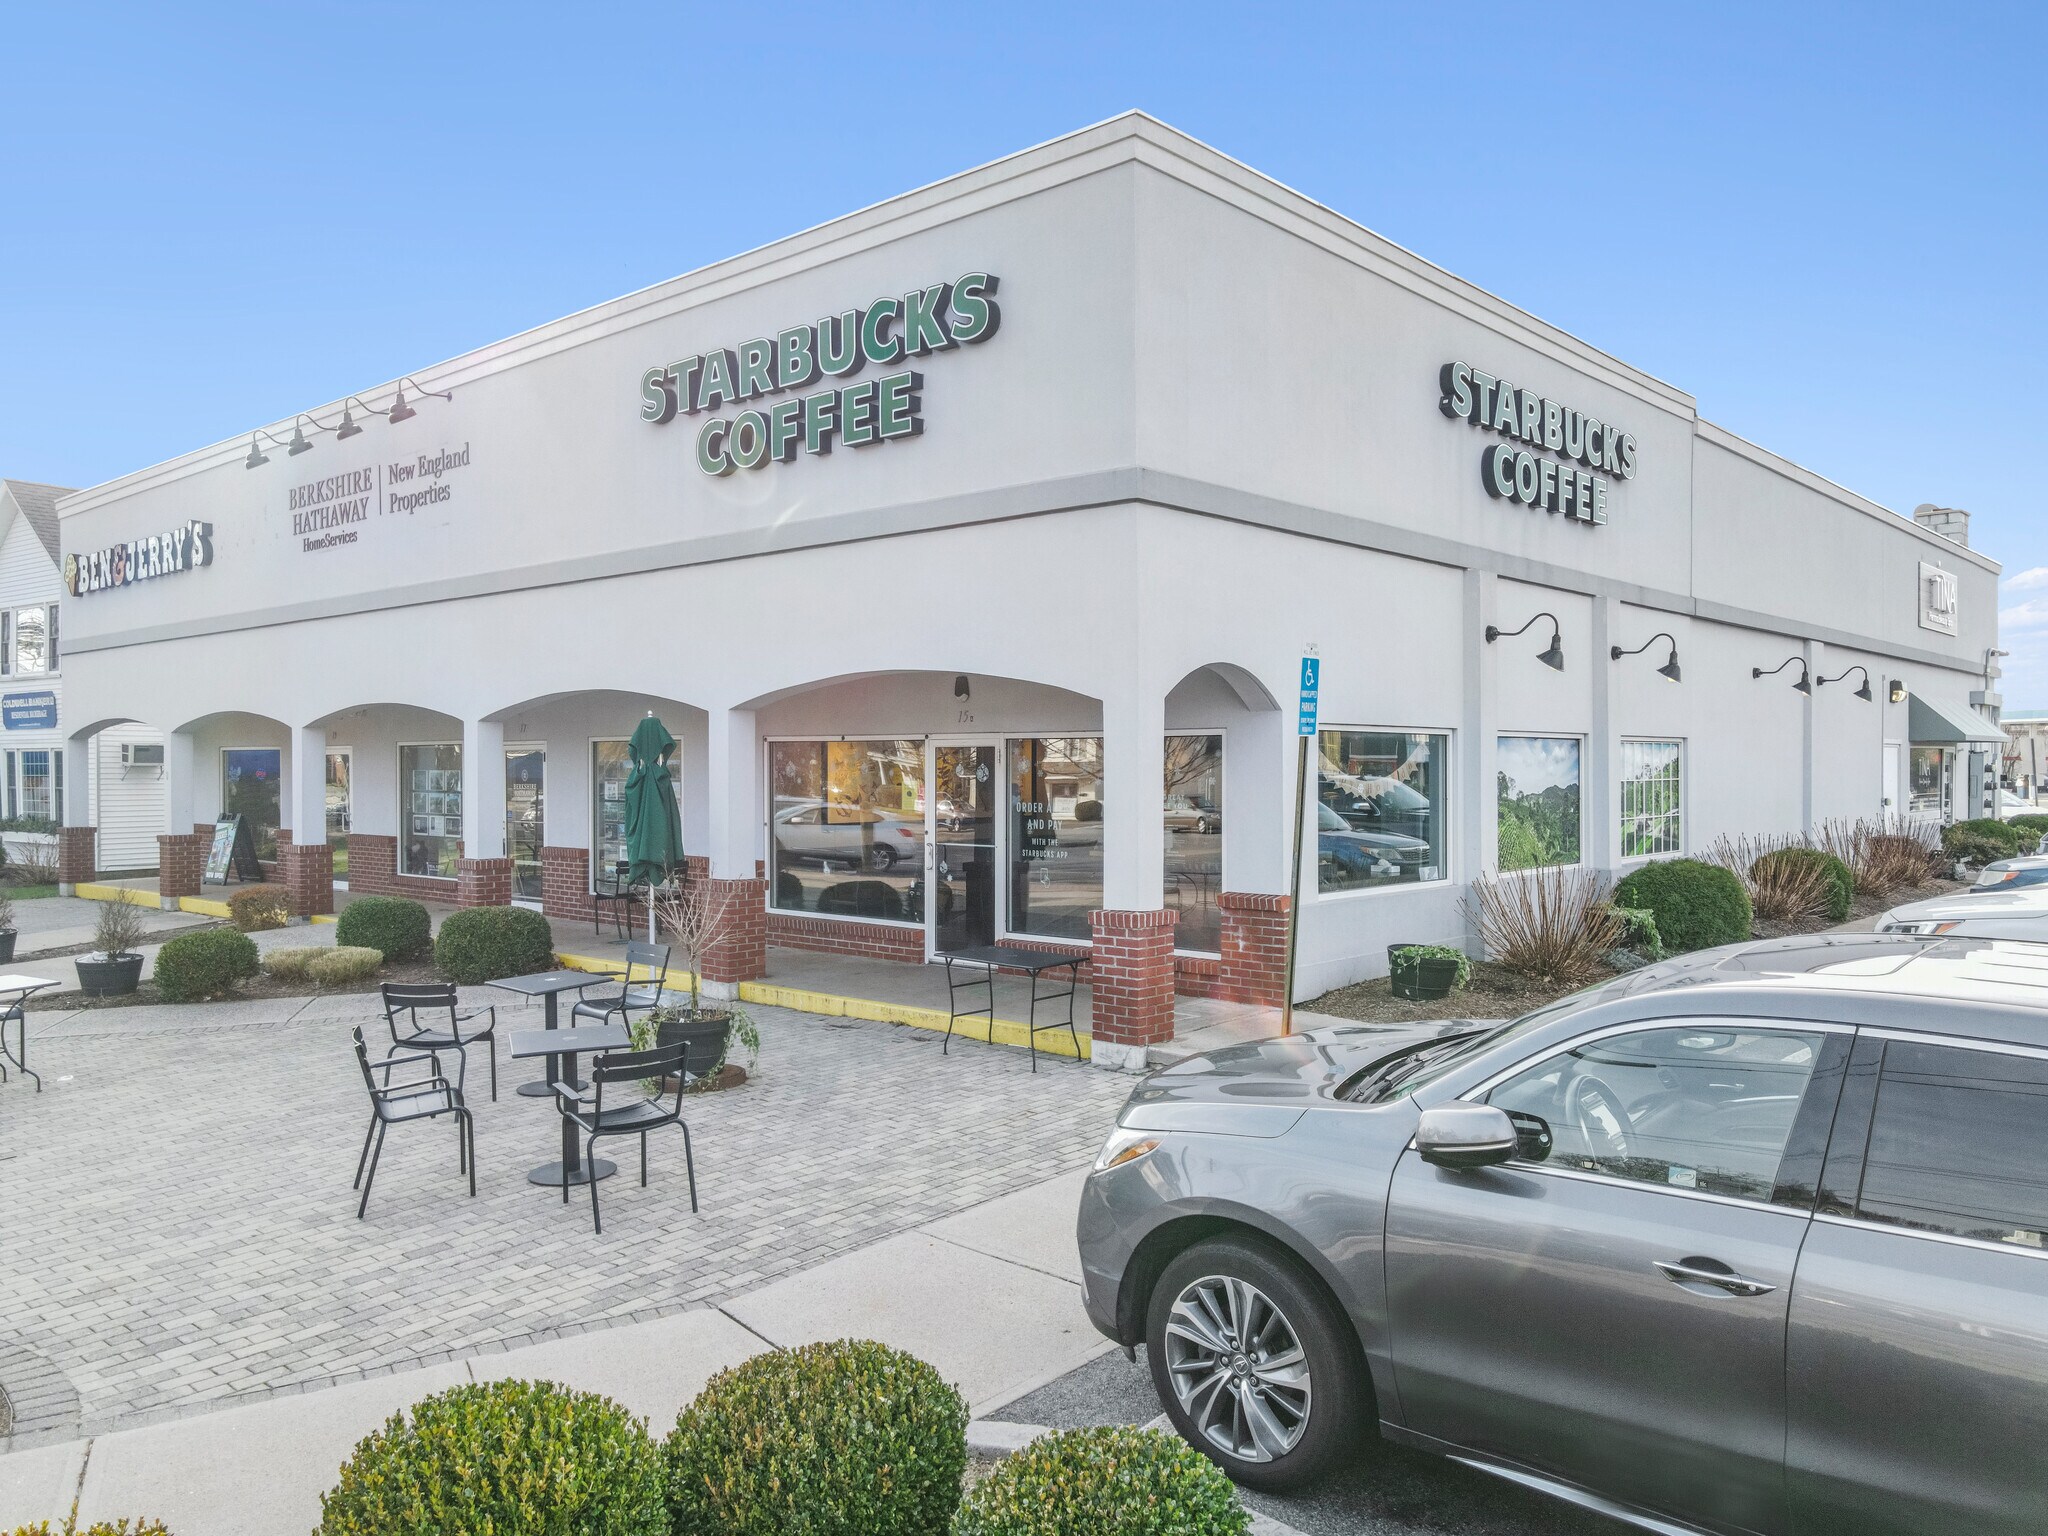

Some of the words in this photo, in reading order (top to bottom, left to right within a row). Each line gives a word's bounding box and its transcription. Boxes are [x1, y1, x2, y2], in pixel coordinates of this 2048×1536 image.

[640, 272, 1000, 424] STARBUCKS
[696, 371, 922, 476] COFFEE
[1439, 361, 1637, 480] STARBUCKS
[388, 463, 415, 485] New
[418, 442, 470, 478] England
[289, 467, 372, 511] BERKSHIRE
[389, 482, 450, 515] Properties
[1481, 443, 1608, 525] COFFEE
[293, 497, 369, 535] HATHAWAY
[303, 530, 358, 552] HomeServices
[1931, 574, 1957, 614] TINA
[1016, 802, 1043, 813] ORDER
[1027, 819, 1045, 830] AND
[1048, 819, 1063, 831] PAY
[1022, 849, 1054, 858] STARBUCKS
[1056, 851, 1069, 859] APP
[1032, 838, 1046, 846] WITH
[1048, 839, 1058, 847] THE
